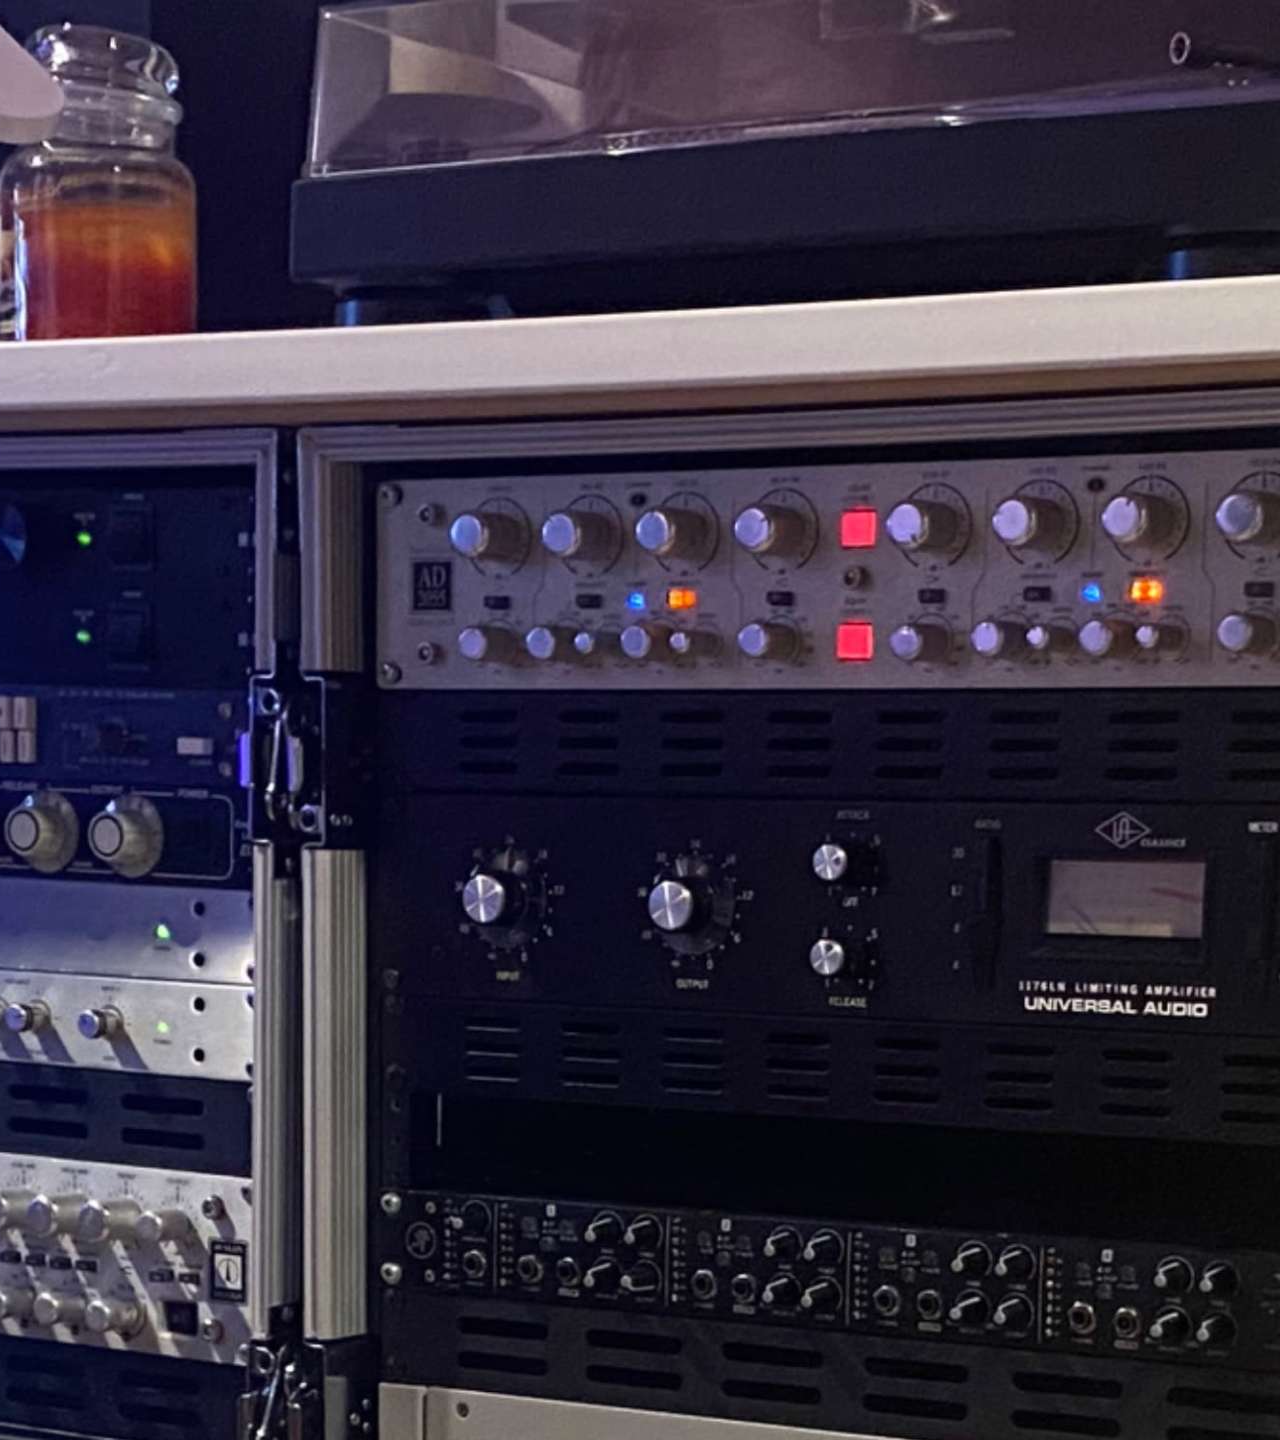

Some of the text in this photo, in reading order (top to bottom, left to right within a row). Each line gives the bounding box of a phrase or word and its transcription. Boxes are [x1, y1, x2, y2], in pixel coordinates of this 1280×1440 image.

[1074, 982, 1139, 996] LIMITING
[1144, 985, 1218, 999] AMPLIFIER
[1023, 996, 1209, 1018] UNIVERSAL AUDIO
